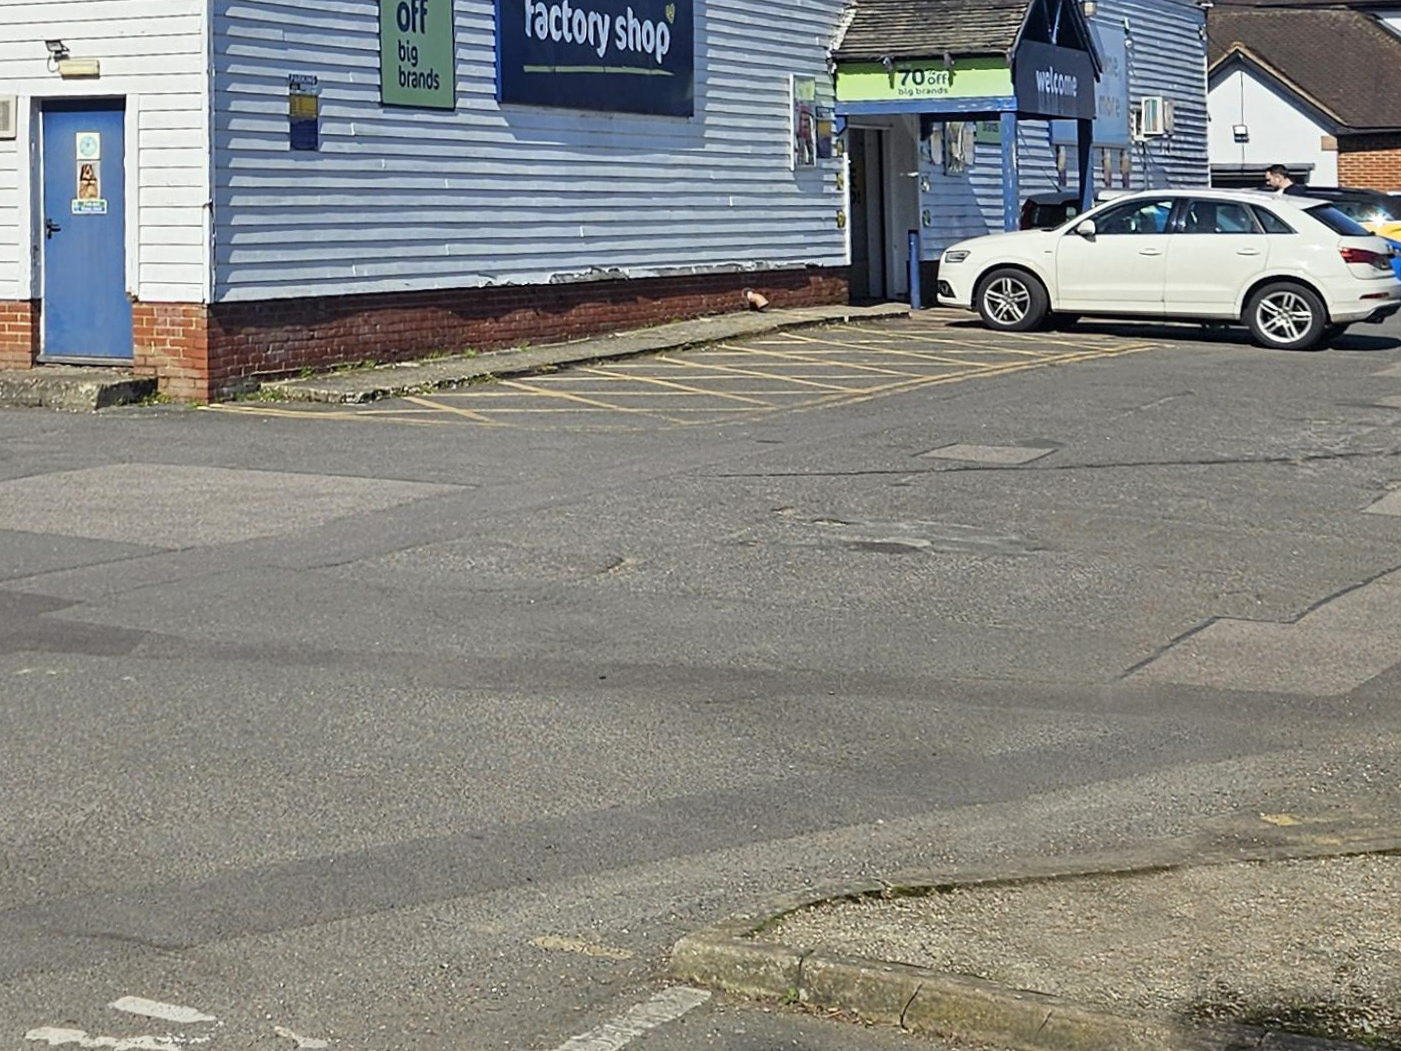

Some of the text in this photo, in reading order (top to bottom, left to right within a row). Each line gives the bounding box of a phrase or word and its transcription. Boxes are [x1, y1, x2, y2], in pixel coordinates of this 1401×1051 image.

[615, 6, 671, 64] shop
[398, 39, 419, 68] big
[398, 68, 440, 91] brands
[898, 86, 949, 96] big brands
[927, 73, 948, 86] off
[1035, 66, 1077, 97] welcome
